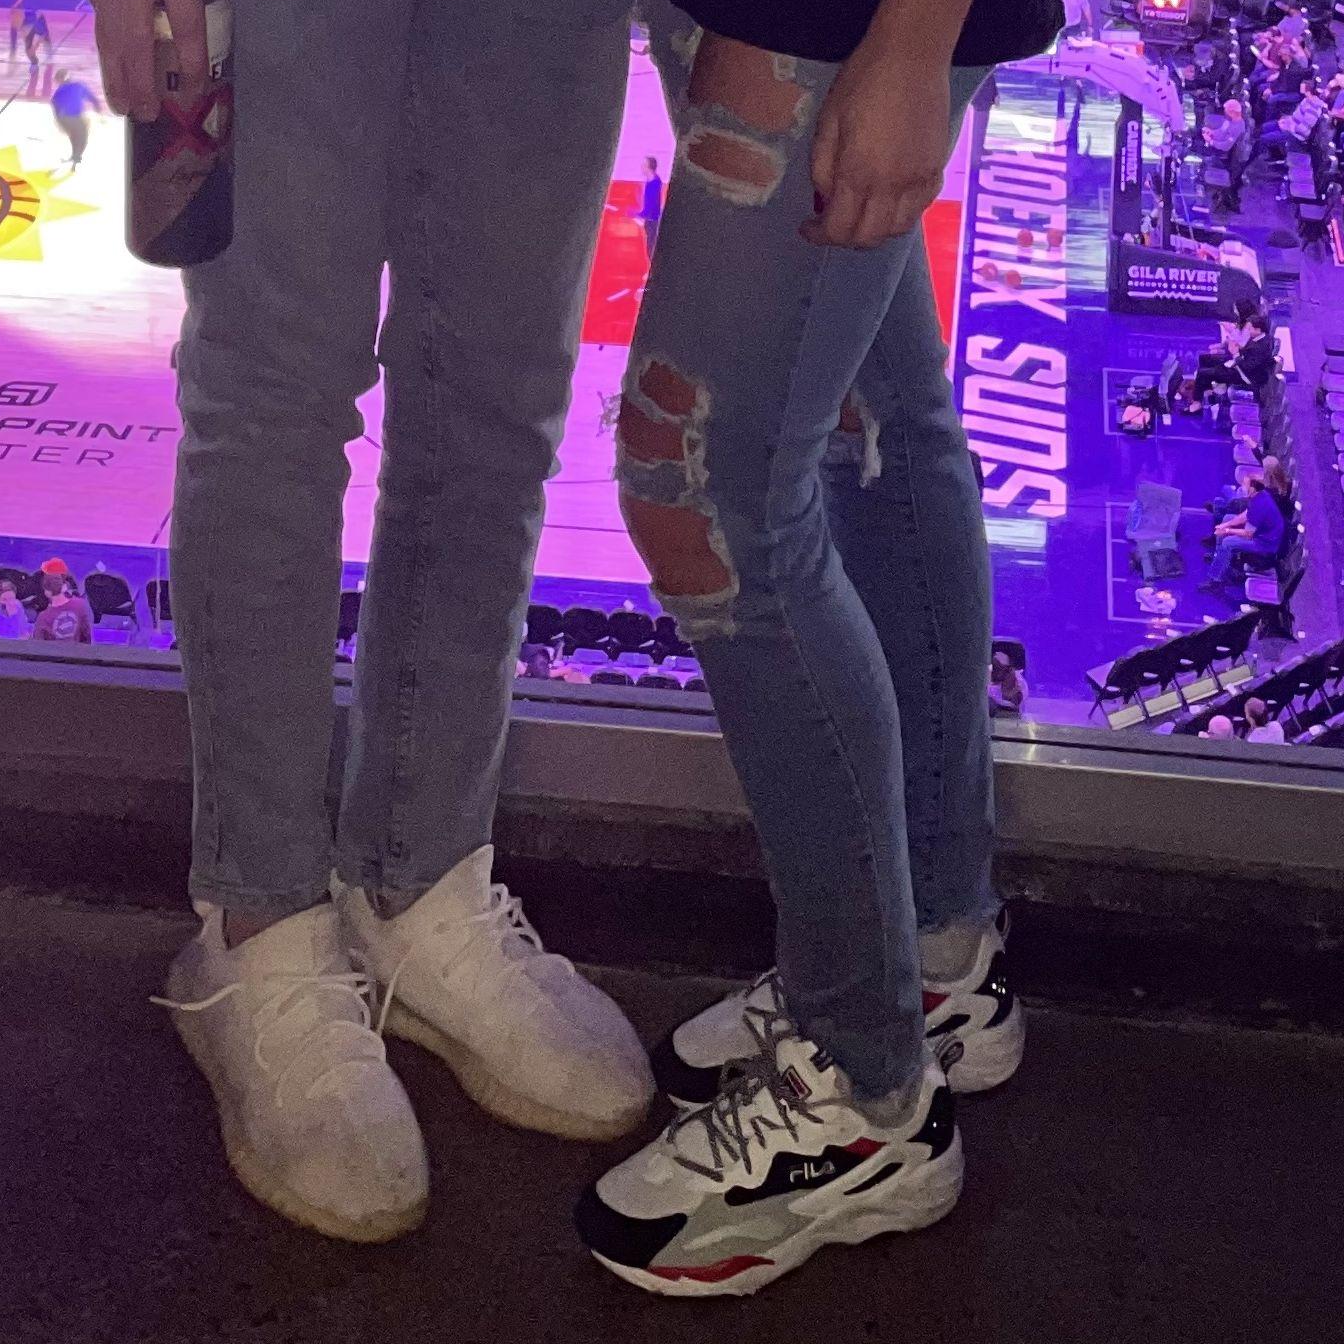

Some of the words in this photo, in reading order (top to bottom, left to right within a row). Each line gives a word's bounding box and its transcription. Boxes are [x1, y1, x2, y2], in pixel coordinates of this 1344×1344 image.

[969, 114, 1068, 324] PHOENIX
[1127, 265, 1167, 281] GILA
[1168, 267, 1219, 284] RIVER
[962, 334, 1068, 519] SUNS
